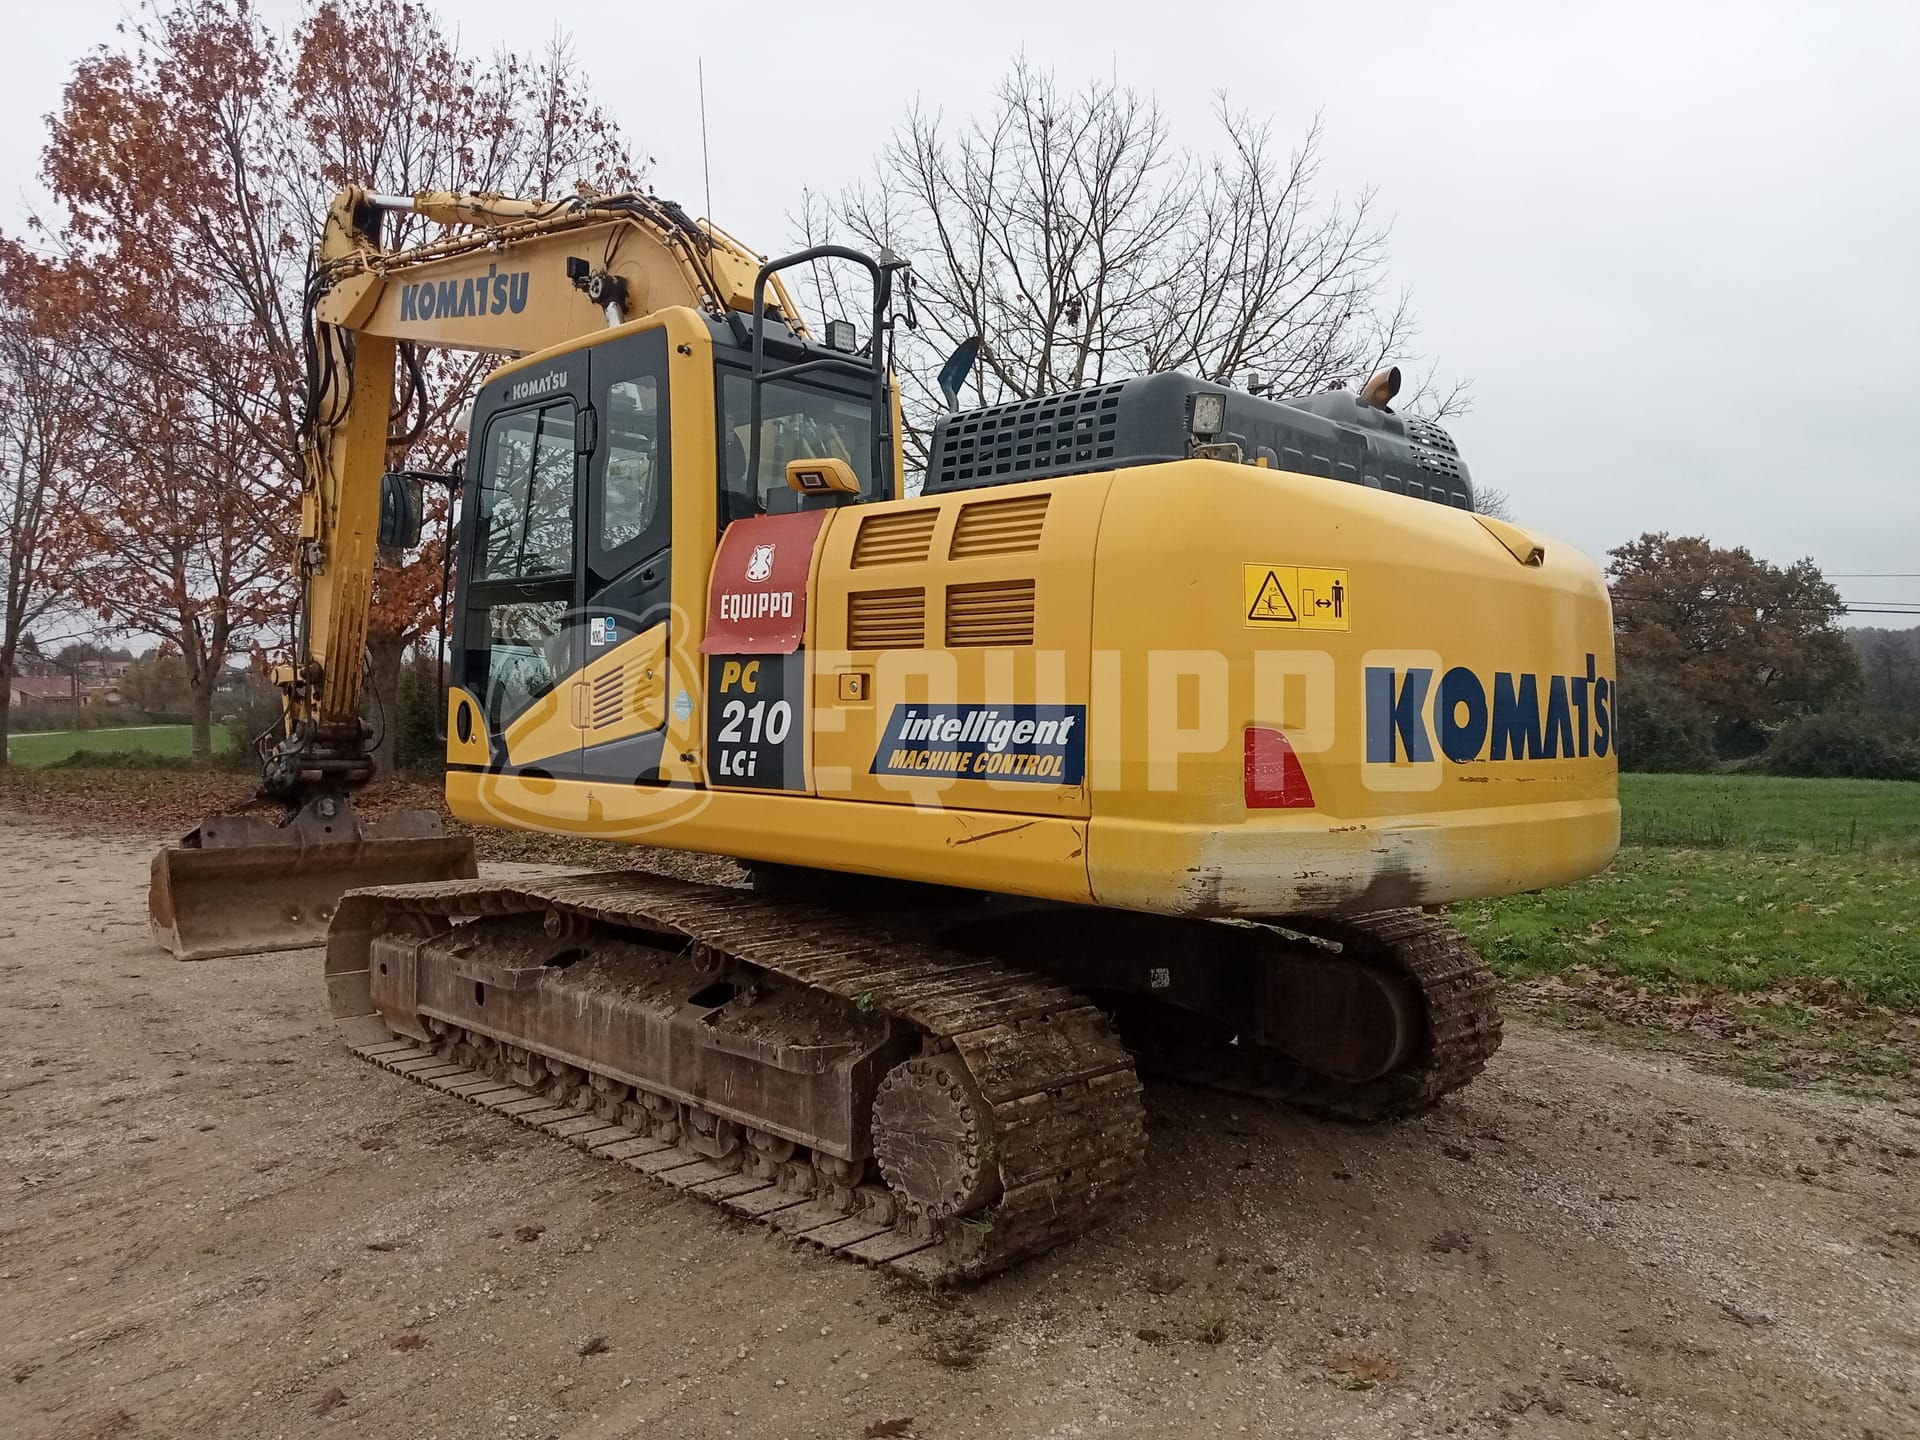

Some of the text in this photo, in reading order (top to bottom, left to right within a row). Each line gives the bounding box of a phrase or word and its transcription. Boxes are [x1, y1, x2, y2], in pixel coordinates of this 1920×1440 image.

[400, 264, 530, 321] KOMATSU
[512, 371, 568, 400] KOMATSU
[720, 592, 793, 622] EQUIPPO
[720, 661, 760, 693] PC
[718, 700, 792, 745] 210
[898, 711, 1074, 752] intelligent
[887, 749, 1062, 777] MACHINE CONTROL
